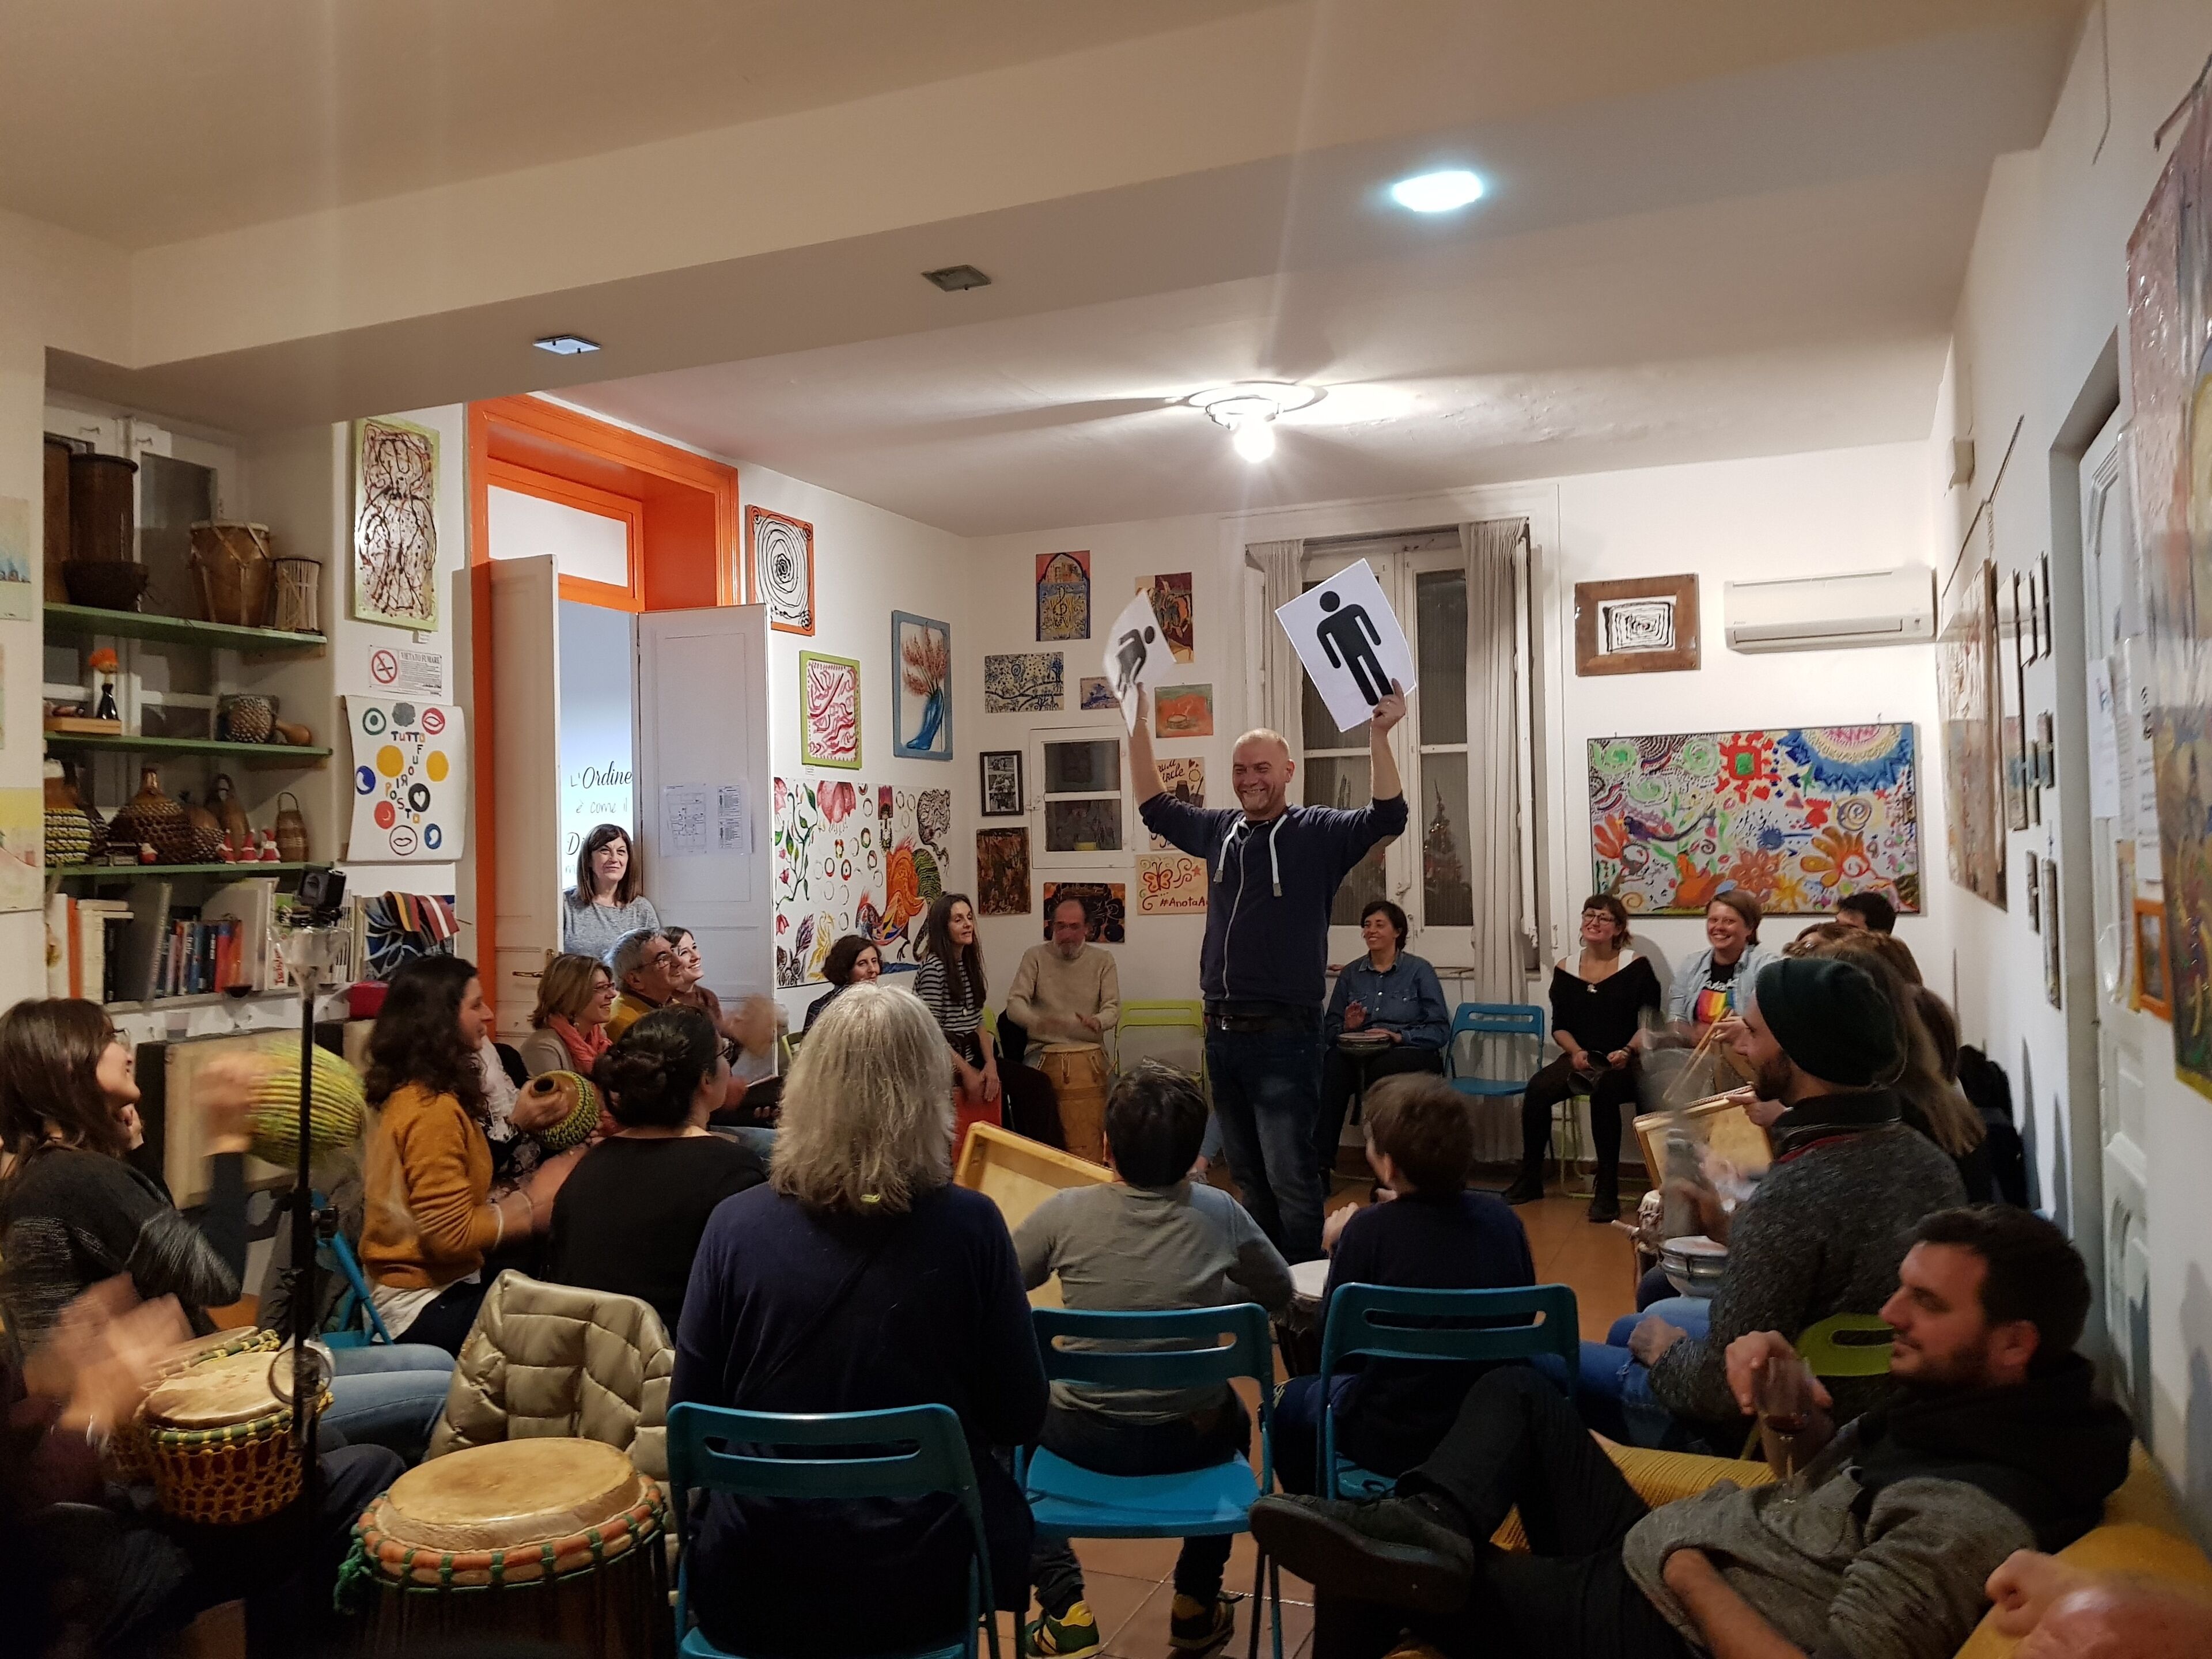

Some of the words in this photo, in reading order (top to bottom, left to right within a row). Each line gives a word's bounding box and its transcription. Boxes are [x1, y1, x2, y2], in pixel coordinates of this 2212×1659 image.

[400, 652, 421, 661] VIETATO
[421, 654, 440, 664] FUMARE
[391, 730, 426, 743] TUTTO
[570, 760, 632, 789] L'Ordine
[590, 801, 616, 813] come
[1160, 896, 1208, 907] #AnotaA
